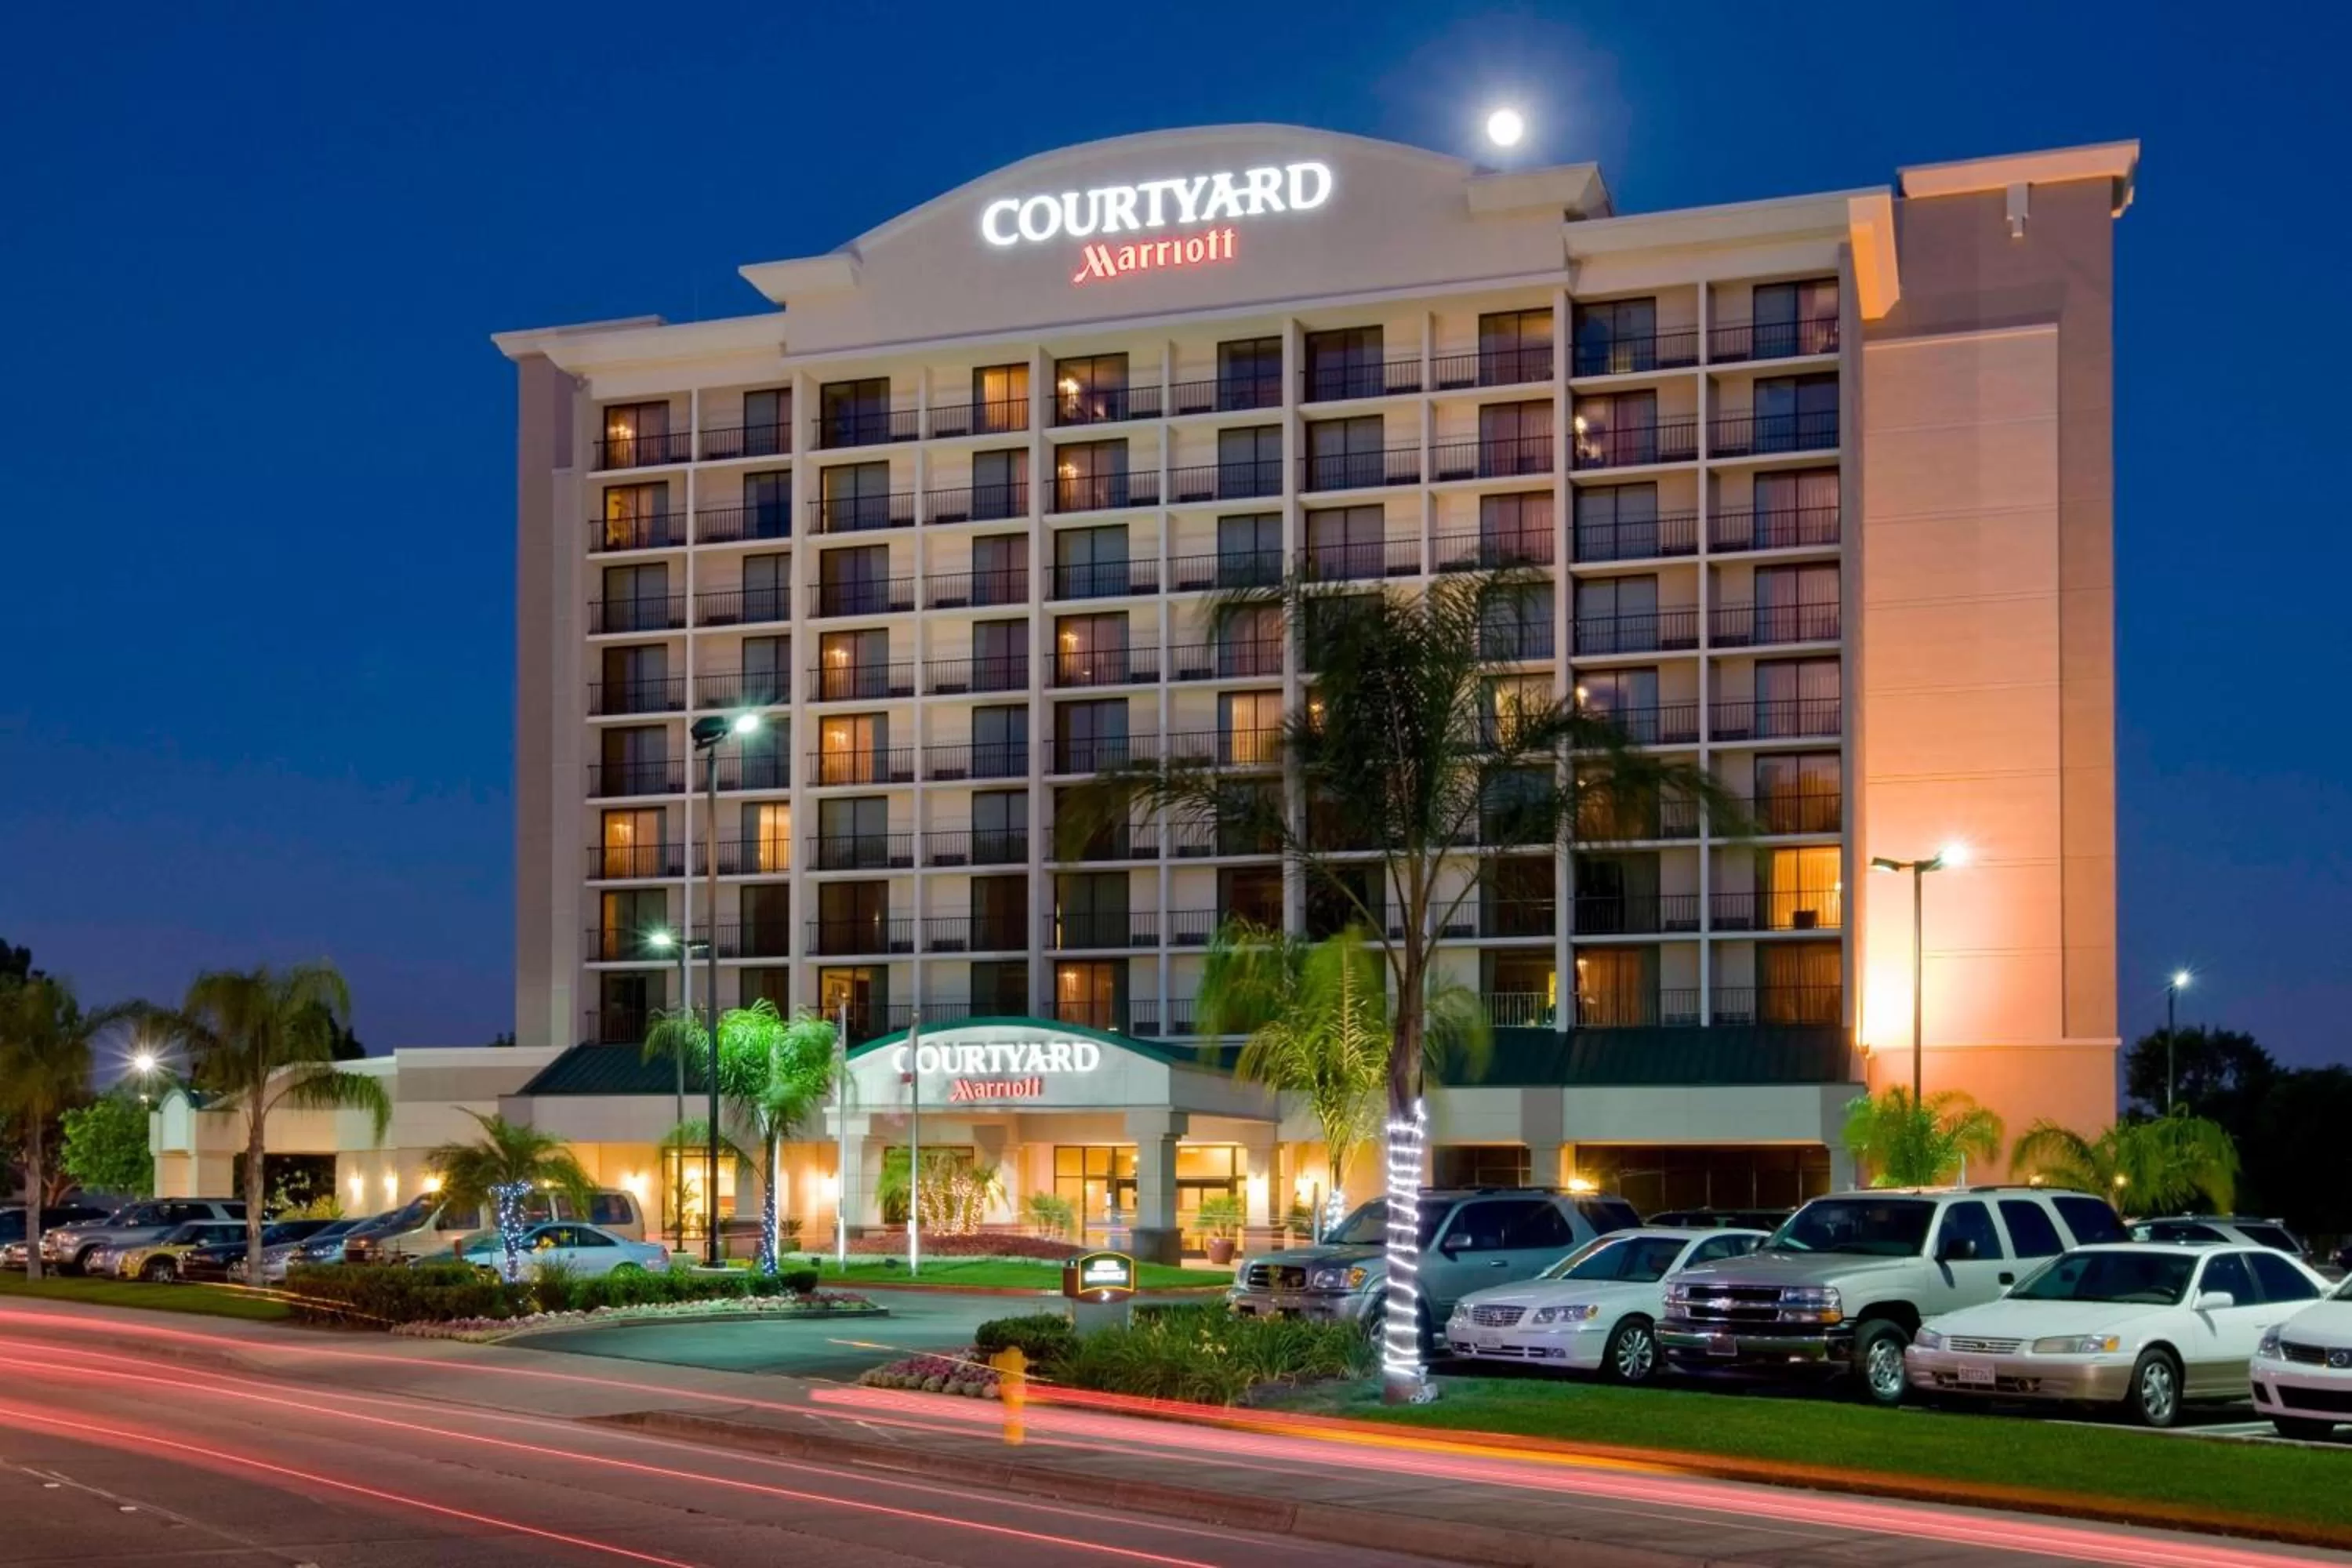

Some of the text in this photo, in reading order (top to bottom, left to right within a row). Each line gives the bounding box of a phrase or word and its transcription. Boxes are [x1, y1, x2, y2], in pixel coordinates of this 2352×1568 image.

[981, 162, 1333, 246] COURTYARD
[1073, 227, 1236, 283] Marriott
[891, 1043, 1100, 1073] COURTYARD
[949, 1076, 1042, 1102] Marriott
